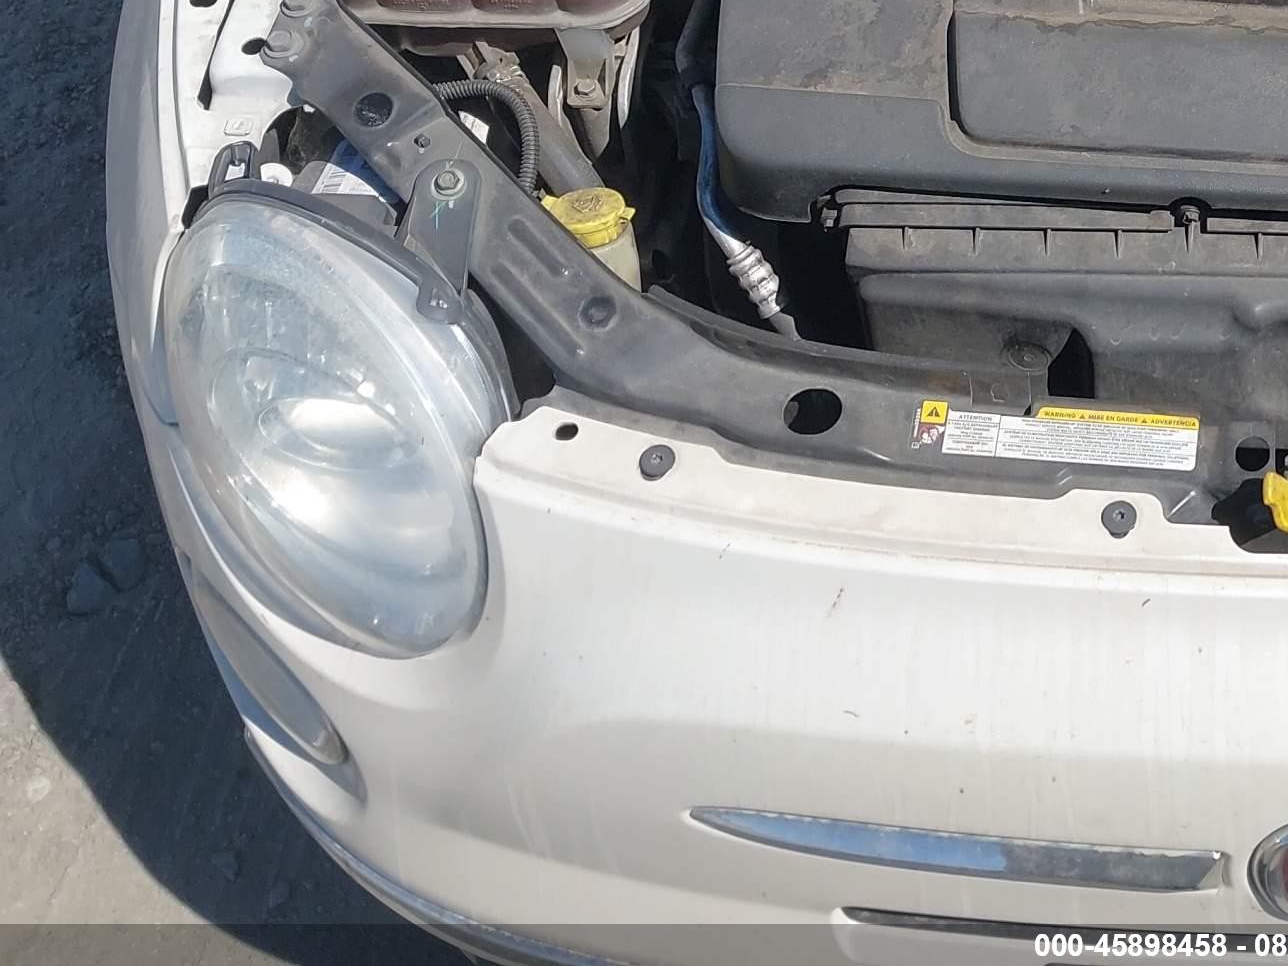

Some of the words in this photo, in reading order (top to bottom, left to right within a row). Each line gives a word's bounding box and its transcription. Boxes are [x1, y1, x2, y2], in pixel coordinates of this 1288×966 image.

[958, 414, 993, 422] ATTENTION
[1044, 410, 1076, 420] WARNING
[1088, 413, 1105, 422] MISE
[1150, 418, 1197, 427] ADVERTENCIA
